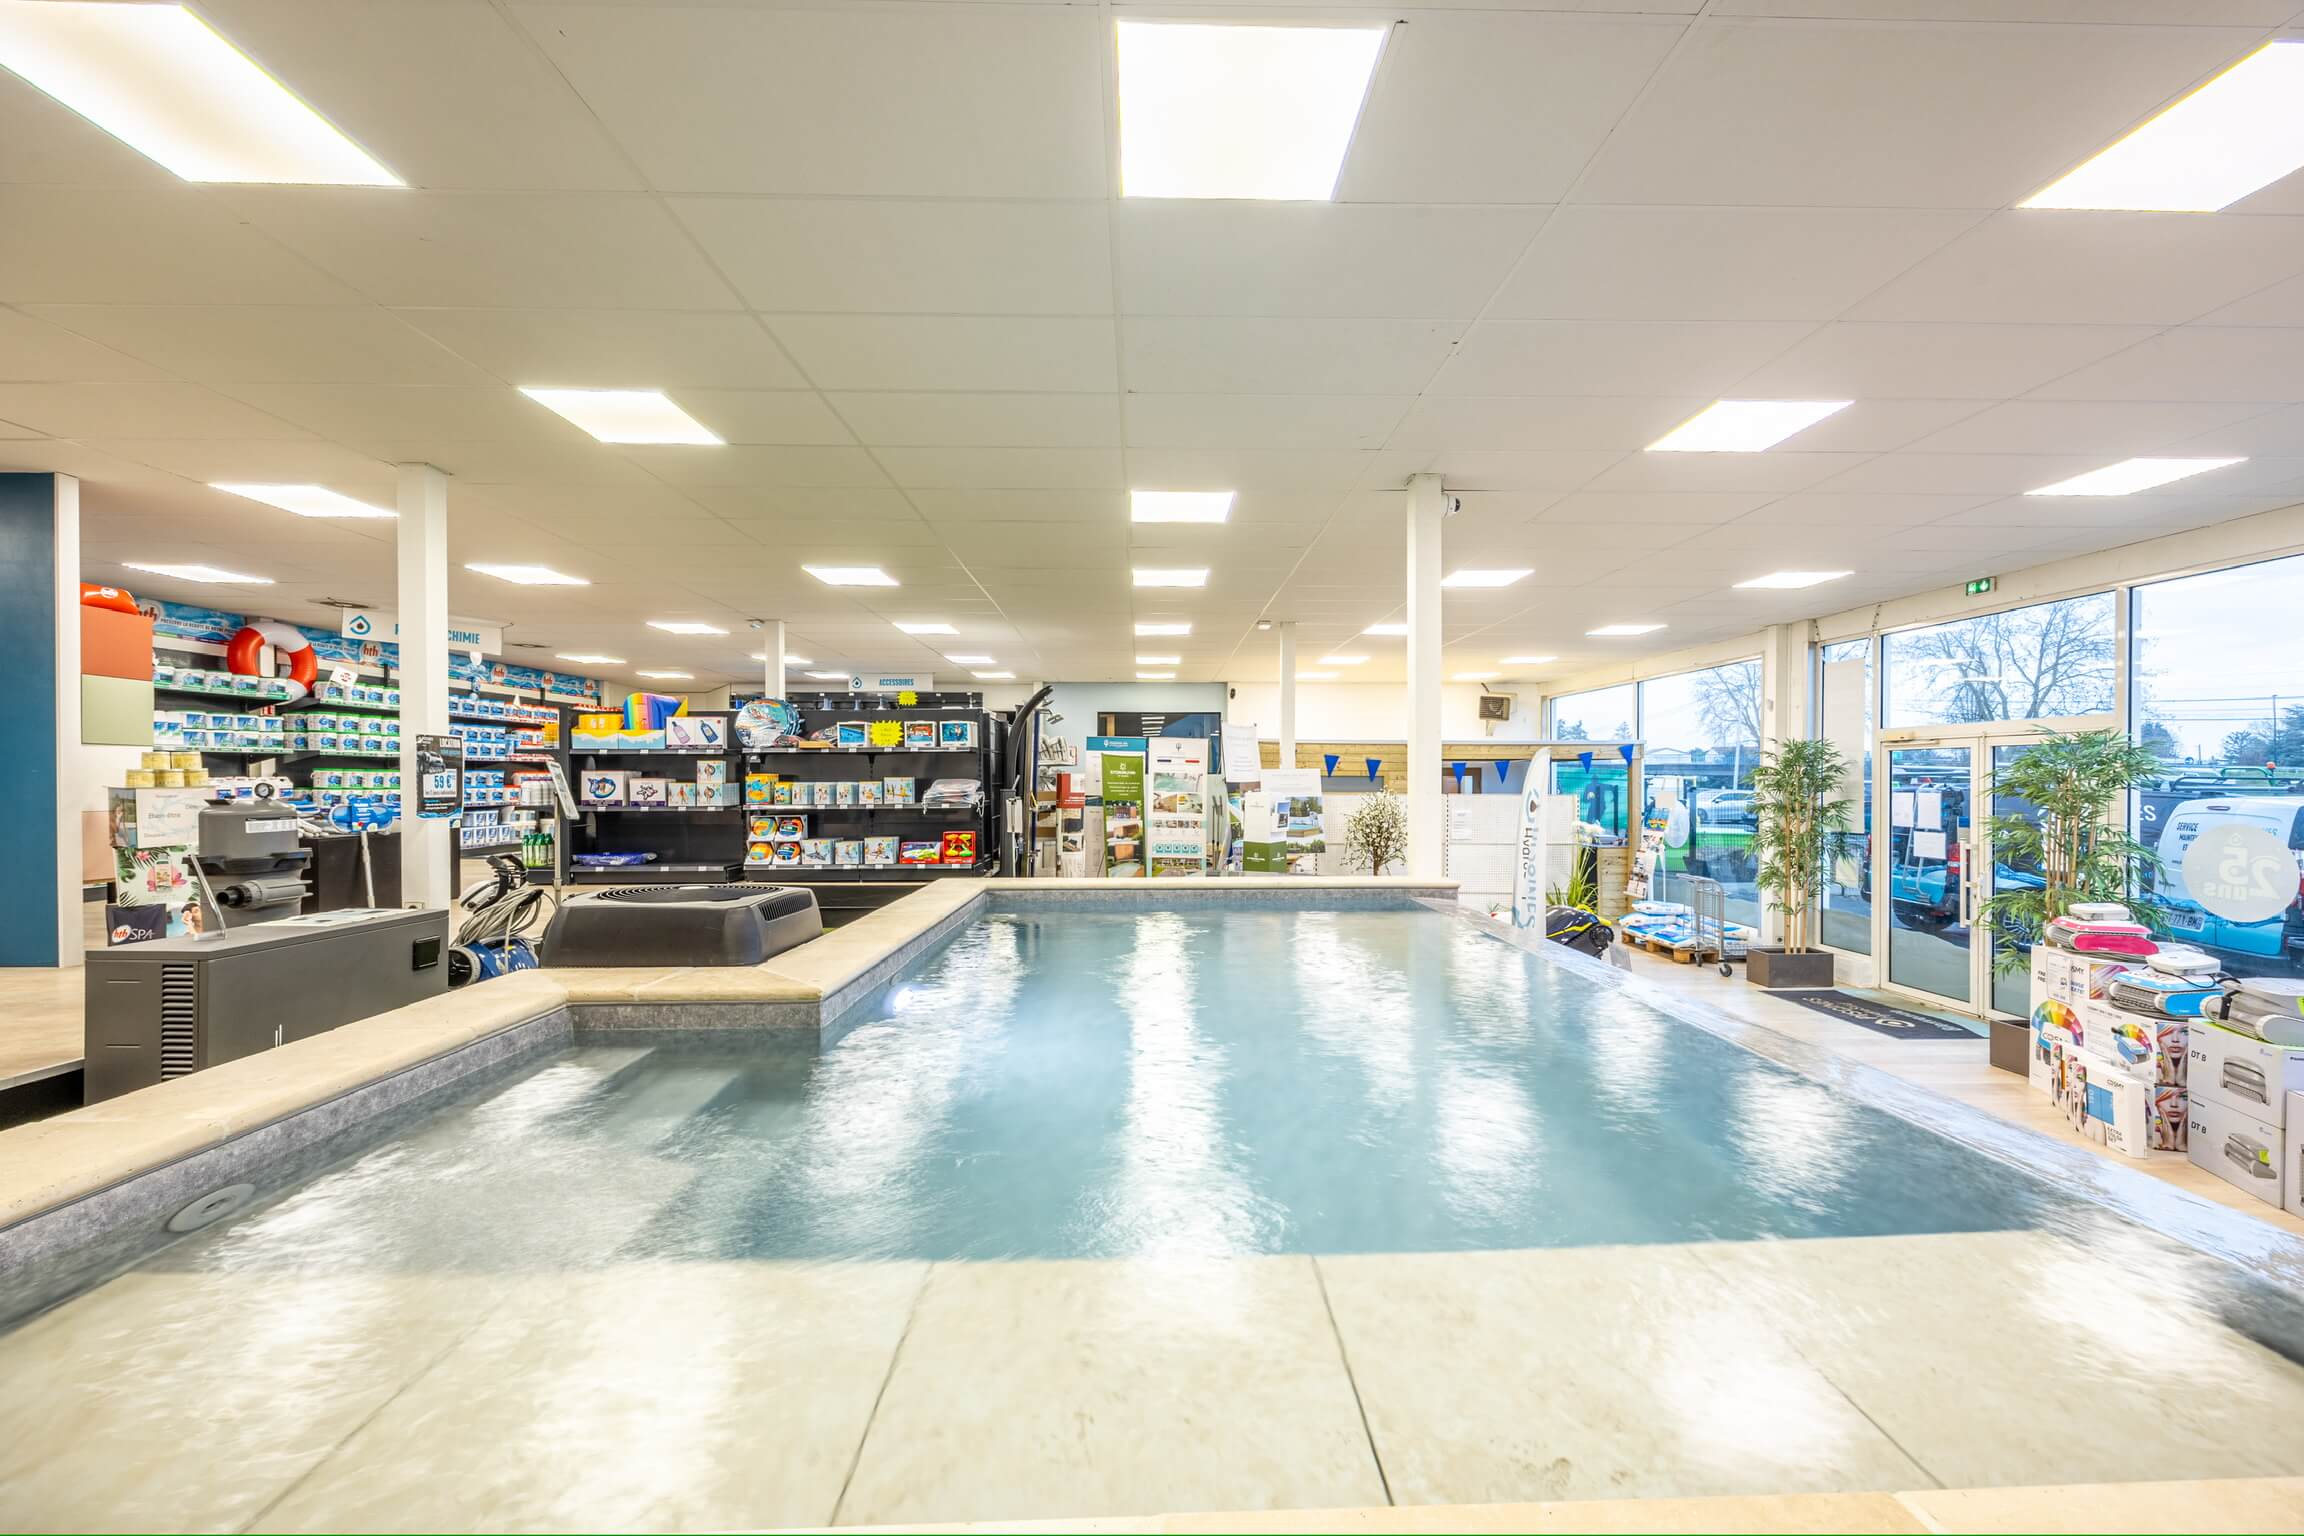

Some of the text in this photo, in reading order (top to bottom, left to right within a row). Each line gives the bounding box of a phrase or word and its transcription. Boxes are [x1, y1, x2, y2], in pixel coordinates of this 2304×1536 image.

[362, 643, 379, 658] hth
[879, 679, 914, 687] ACCESSOIRES
[434, 775, 444, 789] 59
[130, 928, 153, 940] SPA
